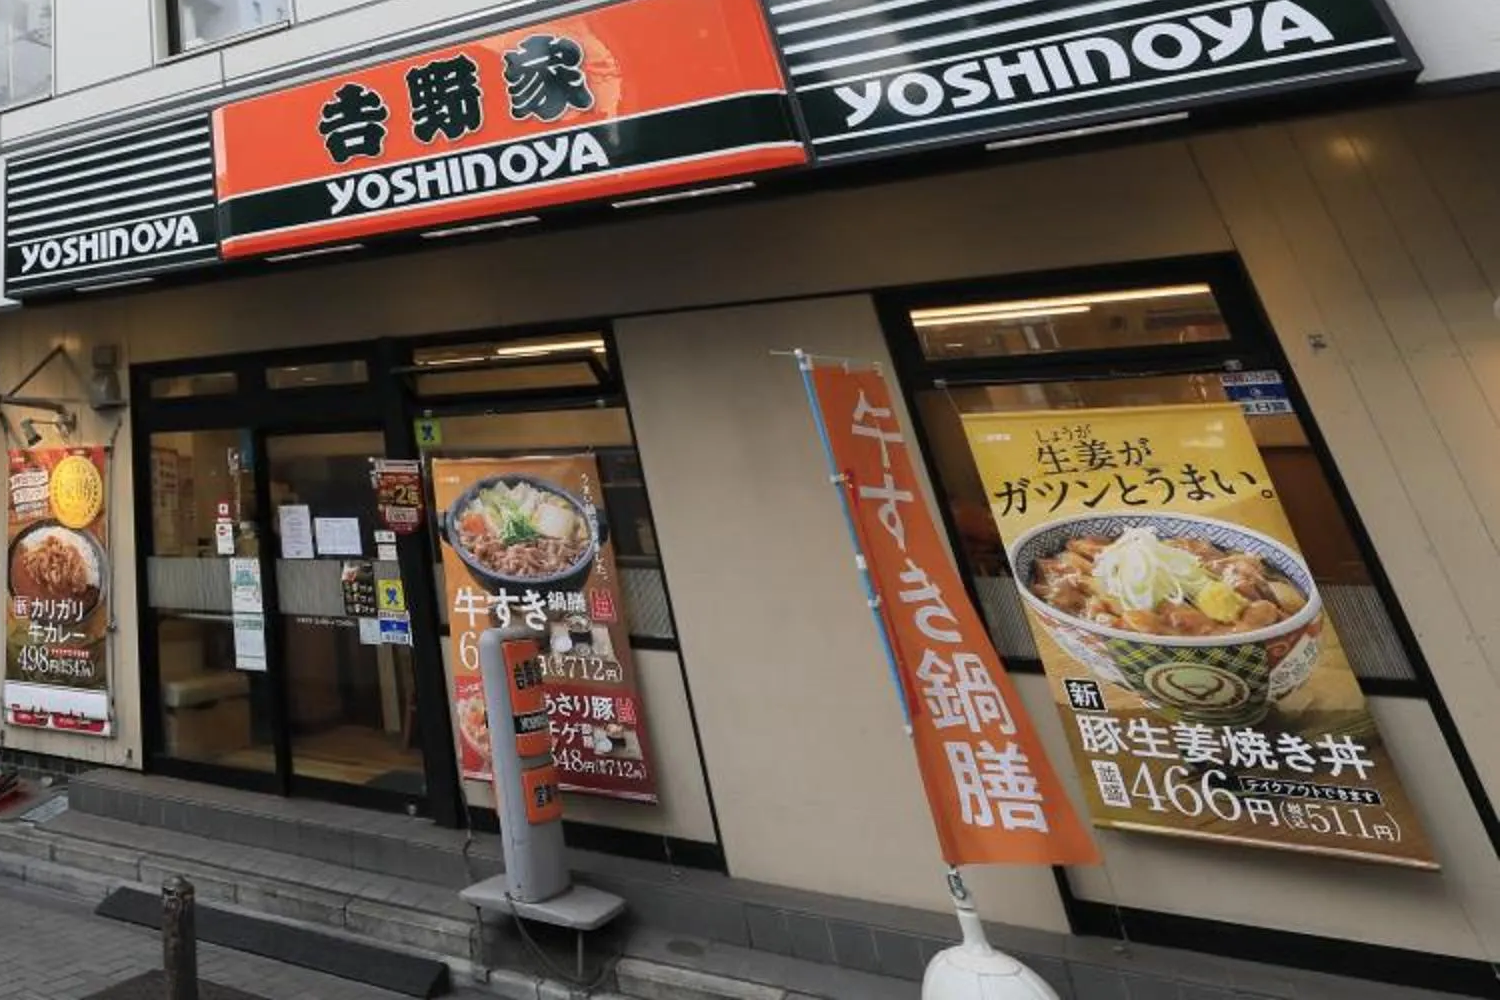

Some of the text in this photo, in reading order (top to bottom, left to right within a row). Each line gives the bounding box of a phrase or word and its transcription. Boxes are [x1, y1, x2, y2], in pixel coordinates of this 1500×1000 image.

[833, 0, 1335, 128] YOSHINOYA
[317, 33, 596, 164] 吉野家
[326, 132, 610, 216] YOSHINOYA
[21, 215, 199, 273] YOSHINOYA
[1037, 437, 1153, 476] 生姜が
[994, 463, 1274, 517] ガツンとうまい。
[850, 389, 1049, 834] 牛すき鍋膳
[1069, 682, 1099, 708] 新
[1075, 714, 1375, 780] 豚生姜焼き丼
